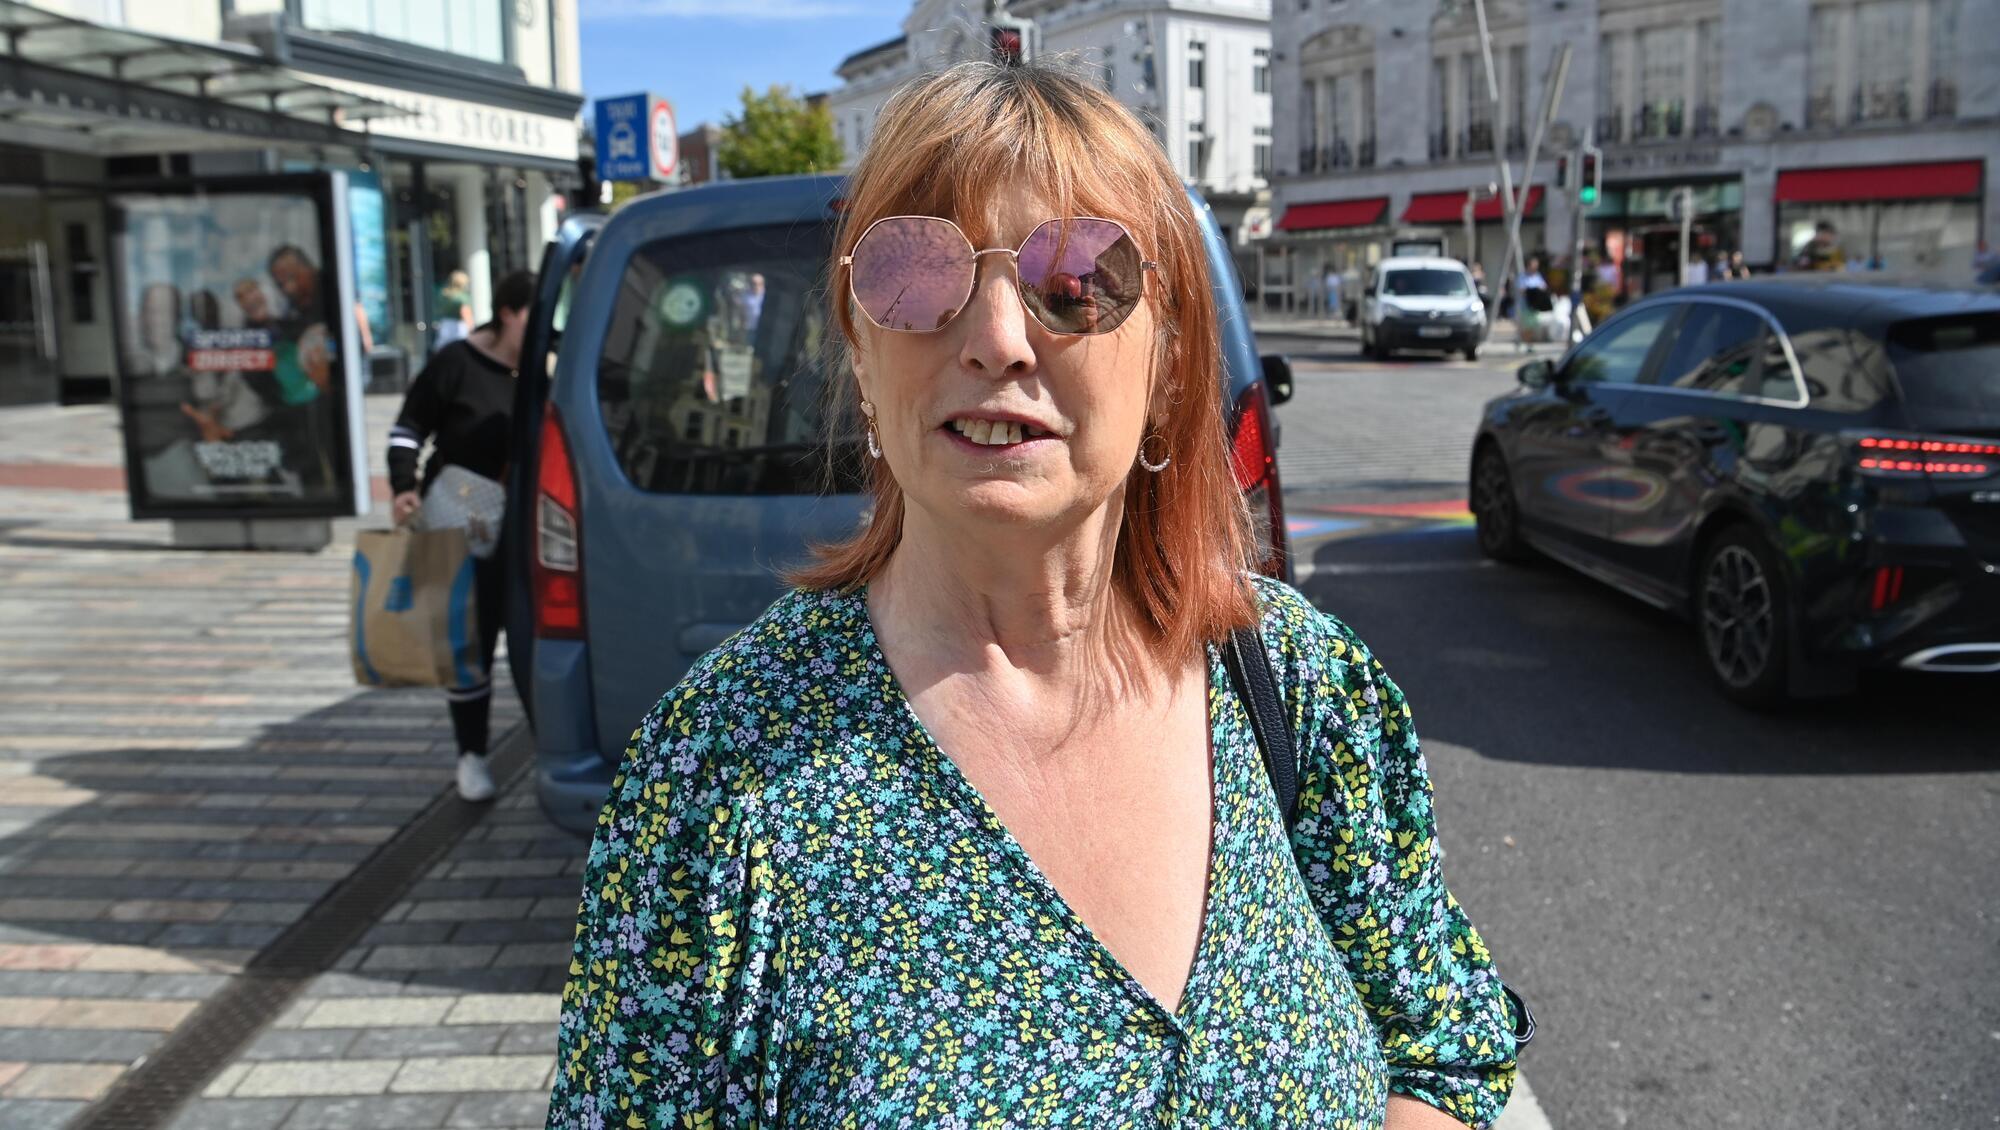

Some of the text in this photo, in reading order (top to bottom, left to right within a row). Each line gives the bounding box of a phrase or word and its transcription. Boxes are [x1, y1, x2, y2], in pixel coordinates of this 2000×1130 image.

[456, 107, 546, 148] STORES
[193, 330, 271, 349] SPORTS
[193, 350, 270, 370] DIRECT
